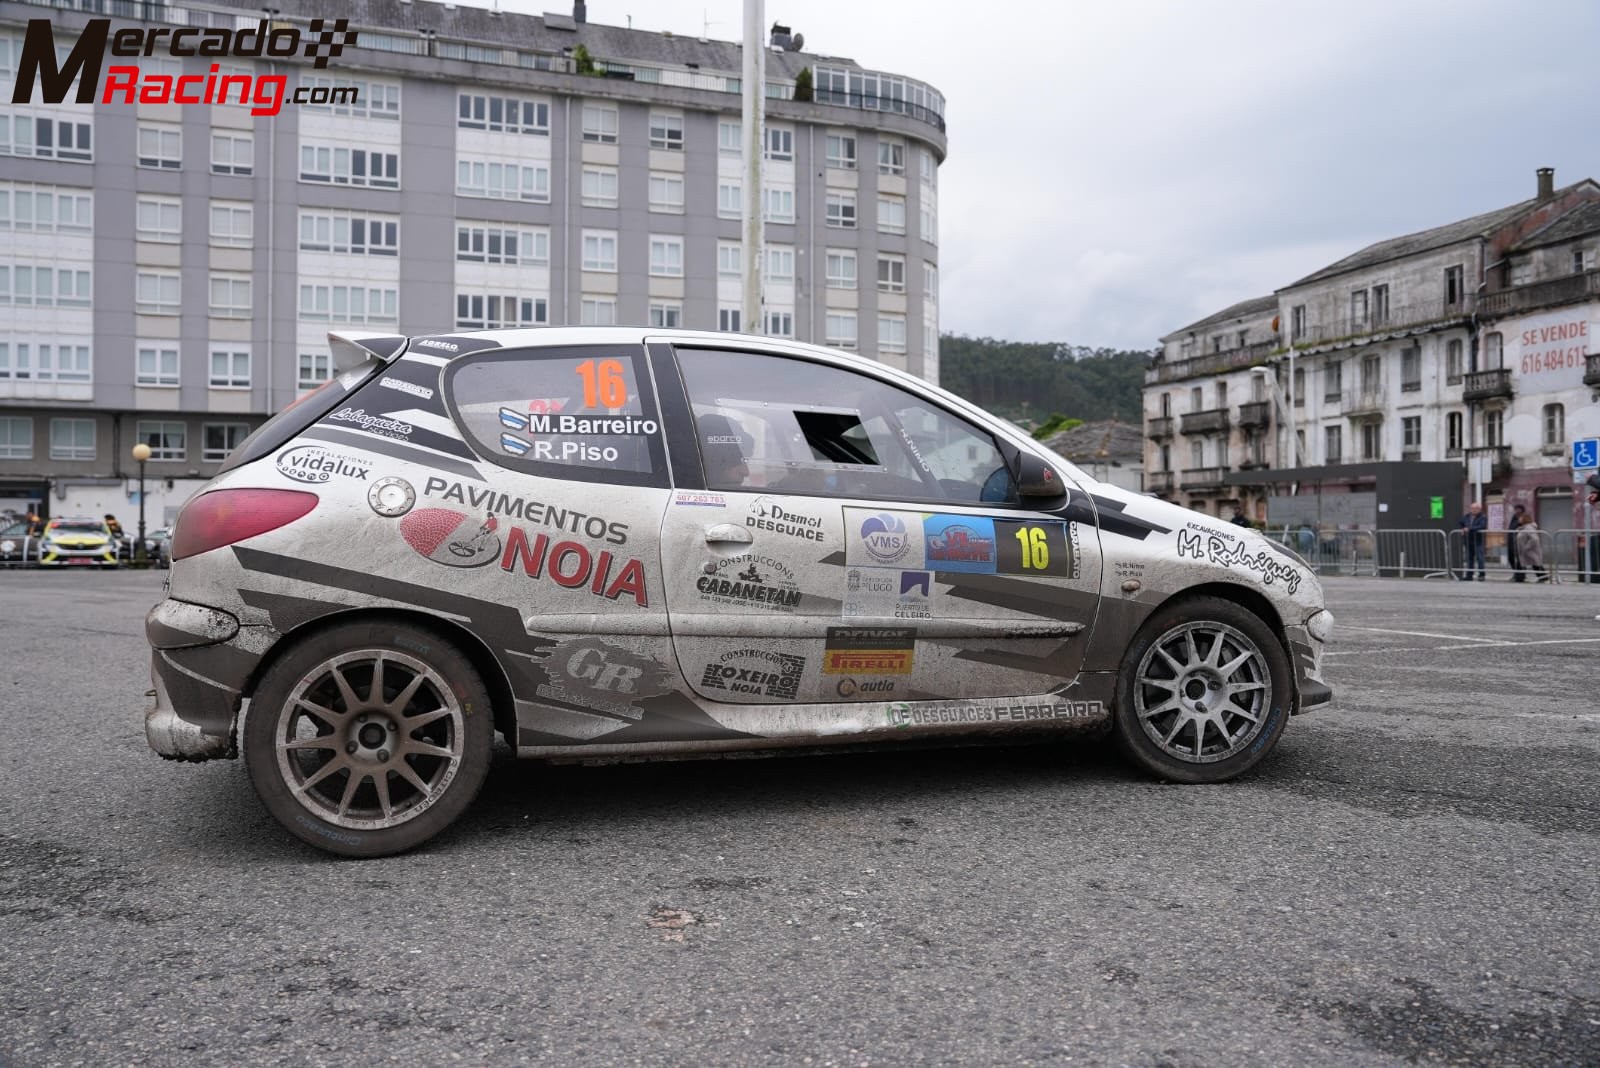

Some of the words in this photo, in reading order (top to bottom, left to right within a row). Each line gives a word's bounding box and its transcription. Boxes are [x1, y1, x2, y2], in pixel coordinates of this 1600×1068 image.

[1523, 330, 1537, 346] SE
[1540, 320, 1587, 343] VENDE
[1522, 352, 1541, 374] 616
[1544, 349, 1564, 371] 484
[575, 359, 627, 409] 16
[529, 415, 658, 434] M.Barreiro
[534, 440, 619, 462] R.Piso
[291, 453, 370, 481] vidalux
[424, 476, 629, 545] PAVIMENTOS
[746, 517, 825, 542] DESGUACE
[870, 535, 901, 549] VMS
[1186, 522, 1236, 542] EXCAVACIONES
[1015, 527, 1049, 569] 16
[1178, 529, 1204, 559] M.
[500, 526, 649, 608] NOIA
[868, 583, 893, 592] LUGO
[894, 611, 931, 619] CELEIRO
[567, 648, 643, 694] GR
[831, 653, 907, 669] PIRELLI
[711, 664, 794, 689] TOXEIRO
[730, 682, 763, 696] NOIA
[913, 706, 993, 724] DESGUACES
[994, 702, 1102, 721] FERREIRO
